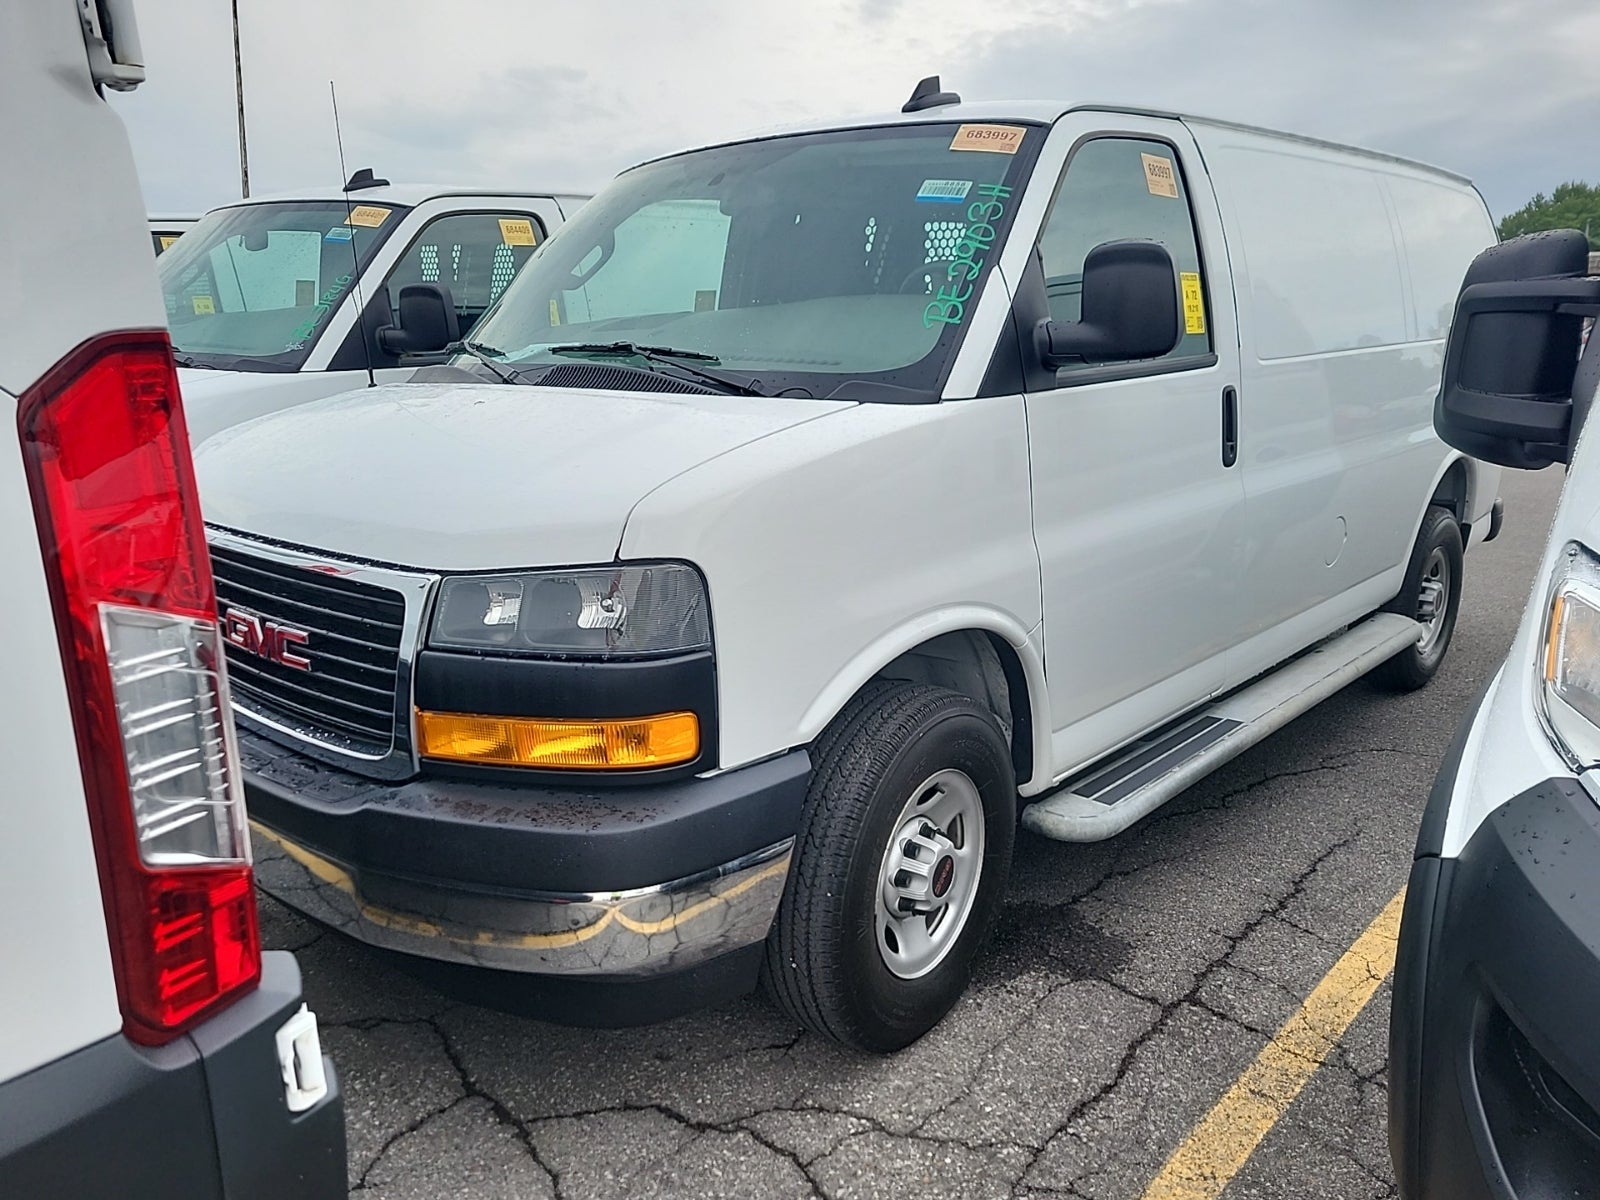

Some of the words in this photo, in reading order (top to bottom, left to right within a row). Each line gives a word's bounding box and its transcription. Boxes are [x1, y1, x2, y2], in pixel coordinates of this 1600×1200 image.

[966, 130, 1018, 142] 683997
[1147, 163, 1171, 180] 683997
[225, 607, 312, 671] GMC
